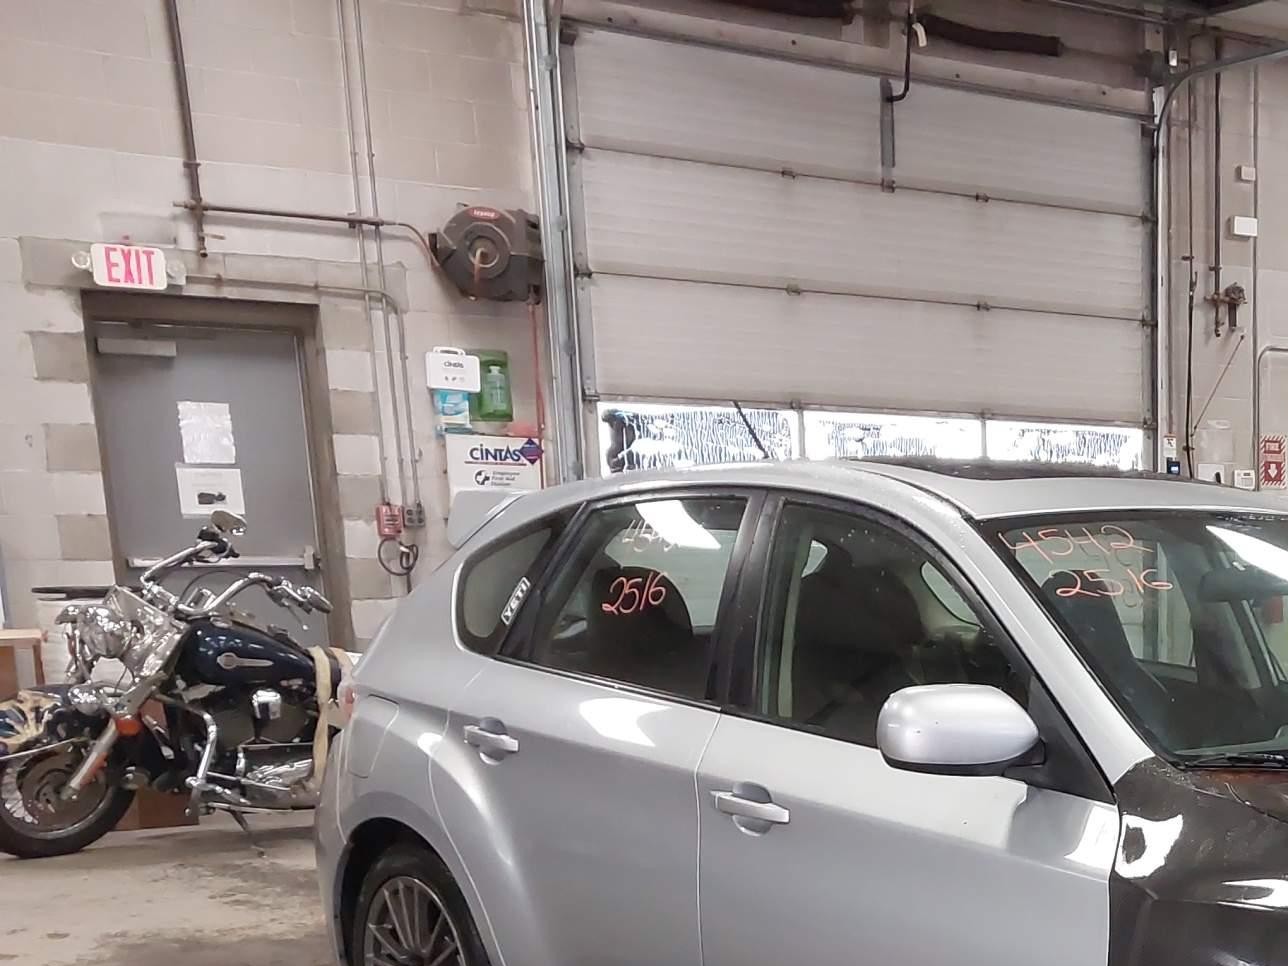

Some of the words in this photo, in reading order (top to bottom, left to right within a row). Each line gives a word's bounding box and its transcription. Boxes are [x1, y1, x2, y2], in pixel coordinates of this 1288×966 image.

[104, 246, 155, 286] EXIT
[469, 443, 521, 462] CINTAS
[997, 525, 1154, 564] 4542
[503, 579, 530, 618] YETI
[602, 571, 667, 615] 2516
[1048, 568, 1173, 597] 2516
